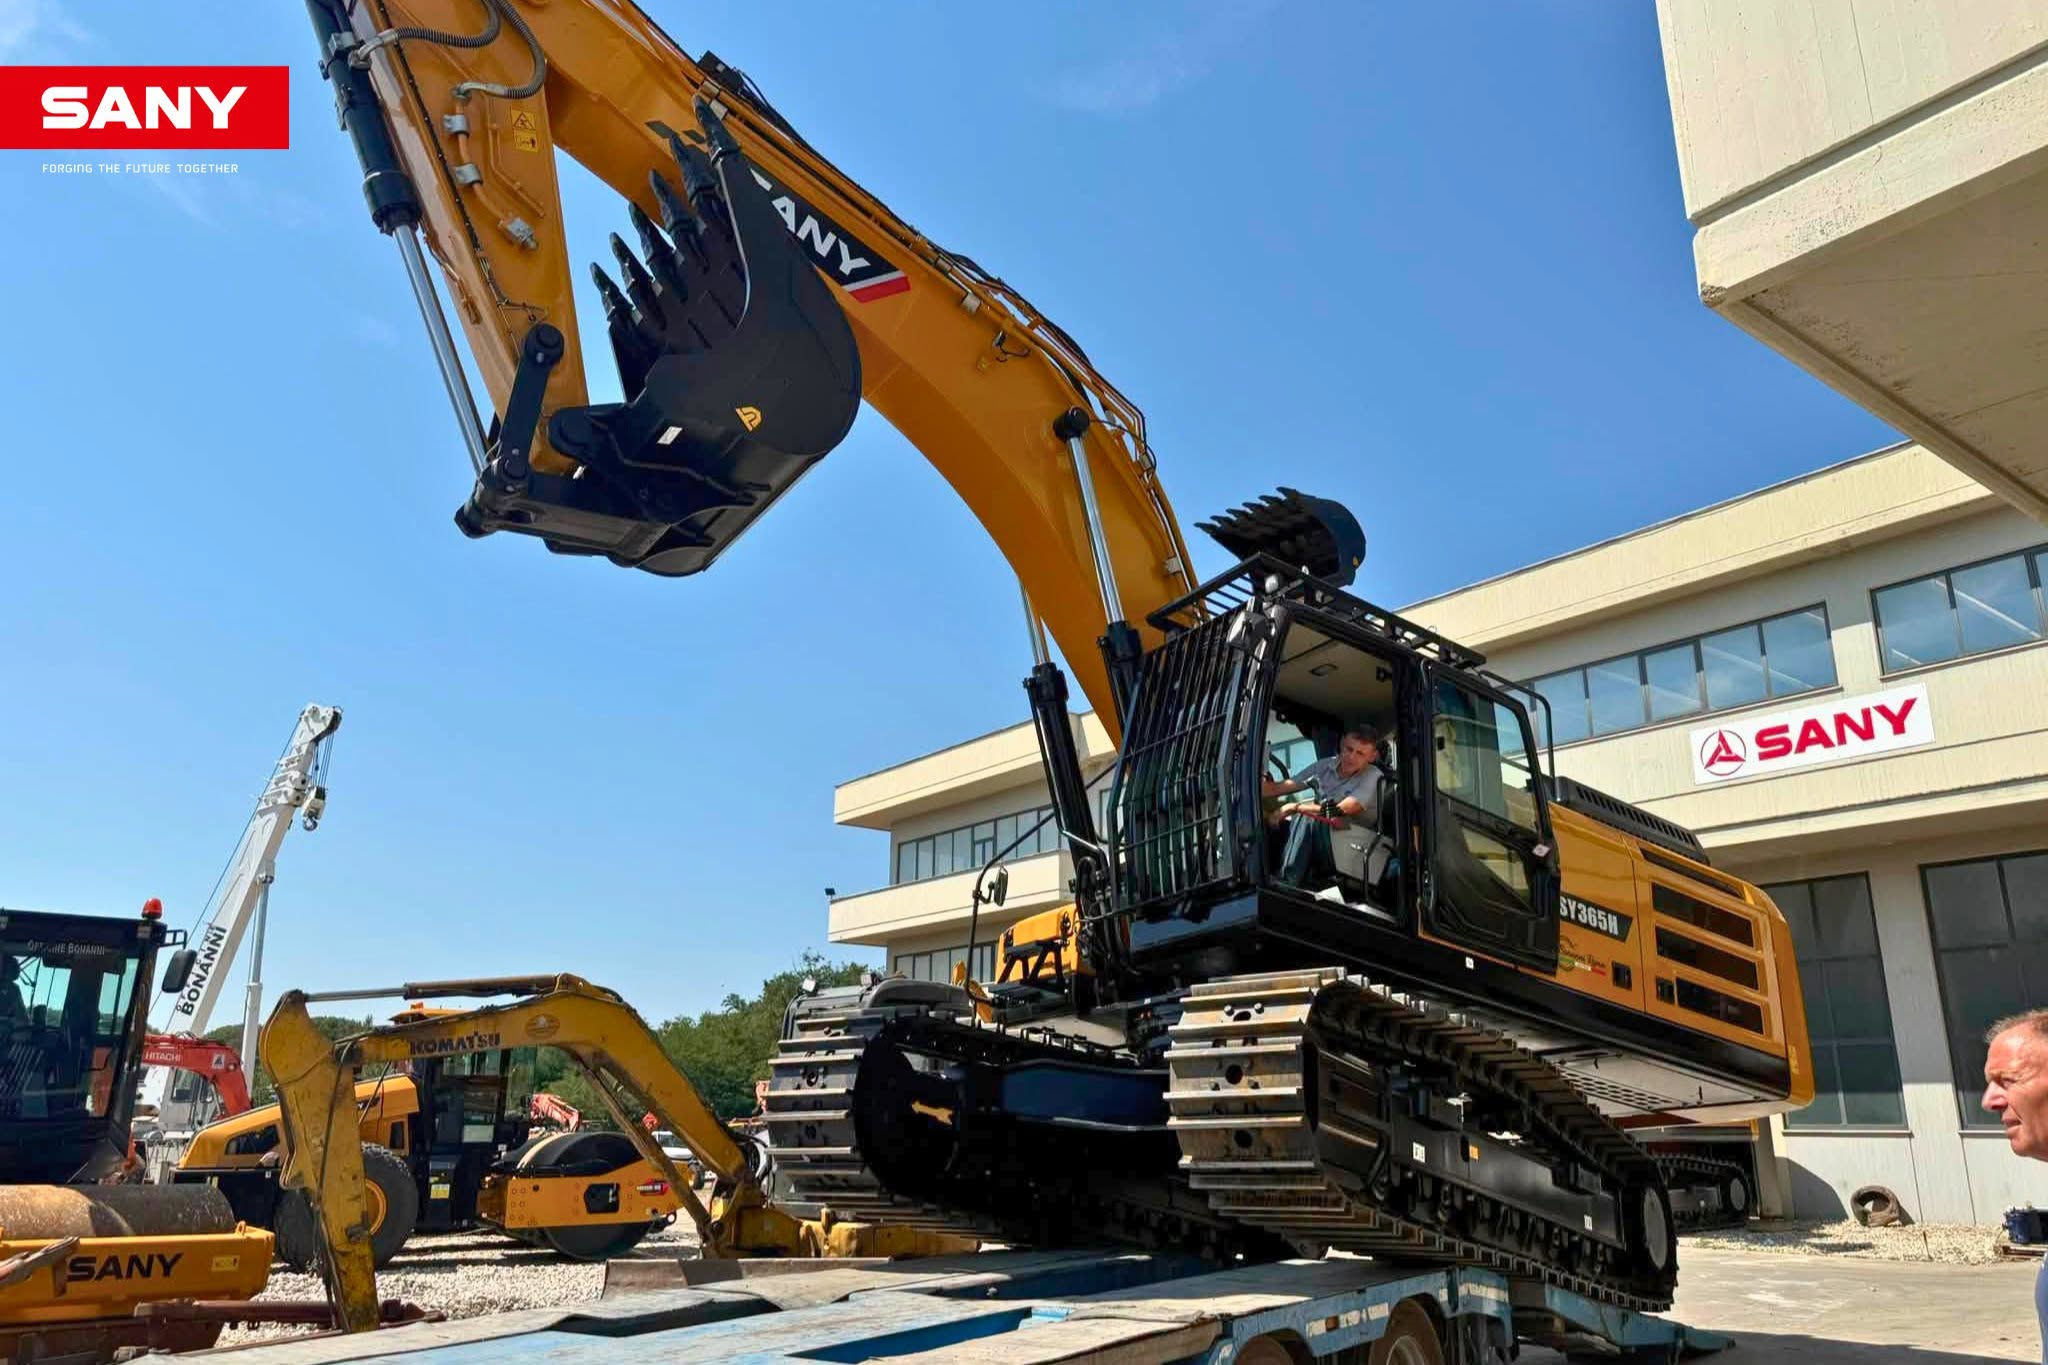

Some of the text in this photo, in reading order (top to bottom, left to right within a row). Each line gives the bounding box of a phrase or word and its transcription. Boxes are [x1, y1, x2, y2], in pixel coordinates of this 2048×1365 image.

[750, 168, 871, 276] ANY
[1754, 697, 1918, 761] SANY
[1560, 895, 1619, 936] SY365H
[181, 926, 227, 1016] BONANNI
[145, 1050, 181, 1062] HITACHI
[410, 1032, 500, 1055] KOMATSU
[67, 1252, 184, 1282] SANY
